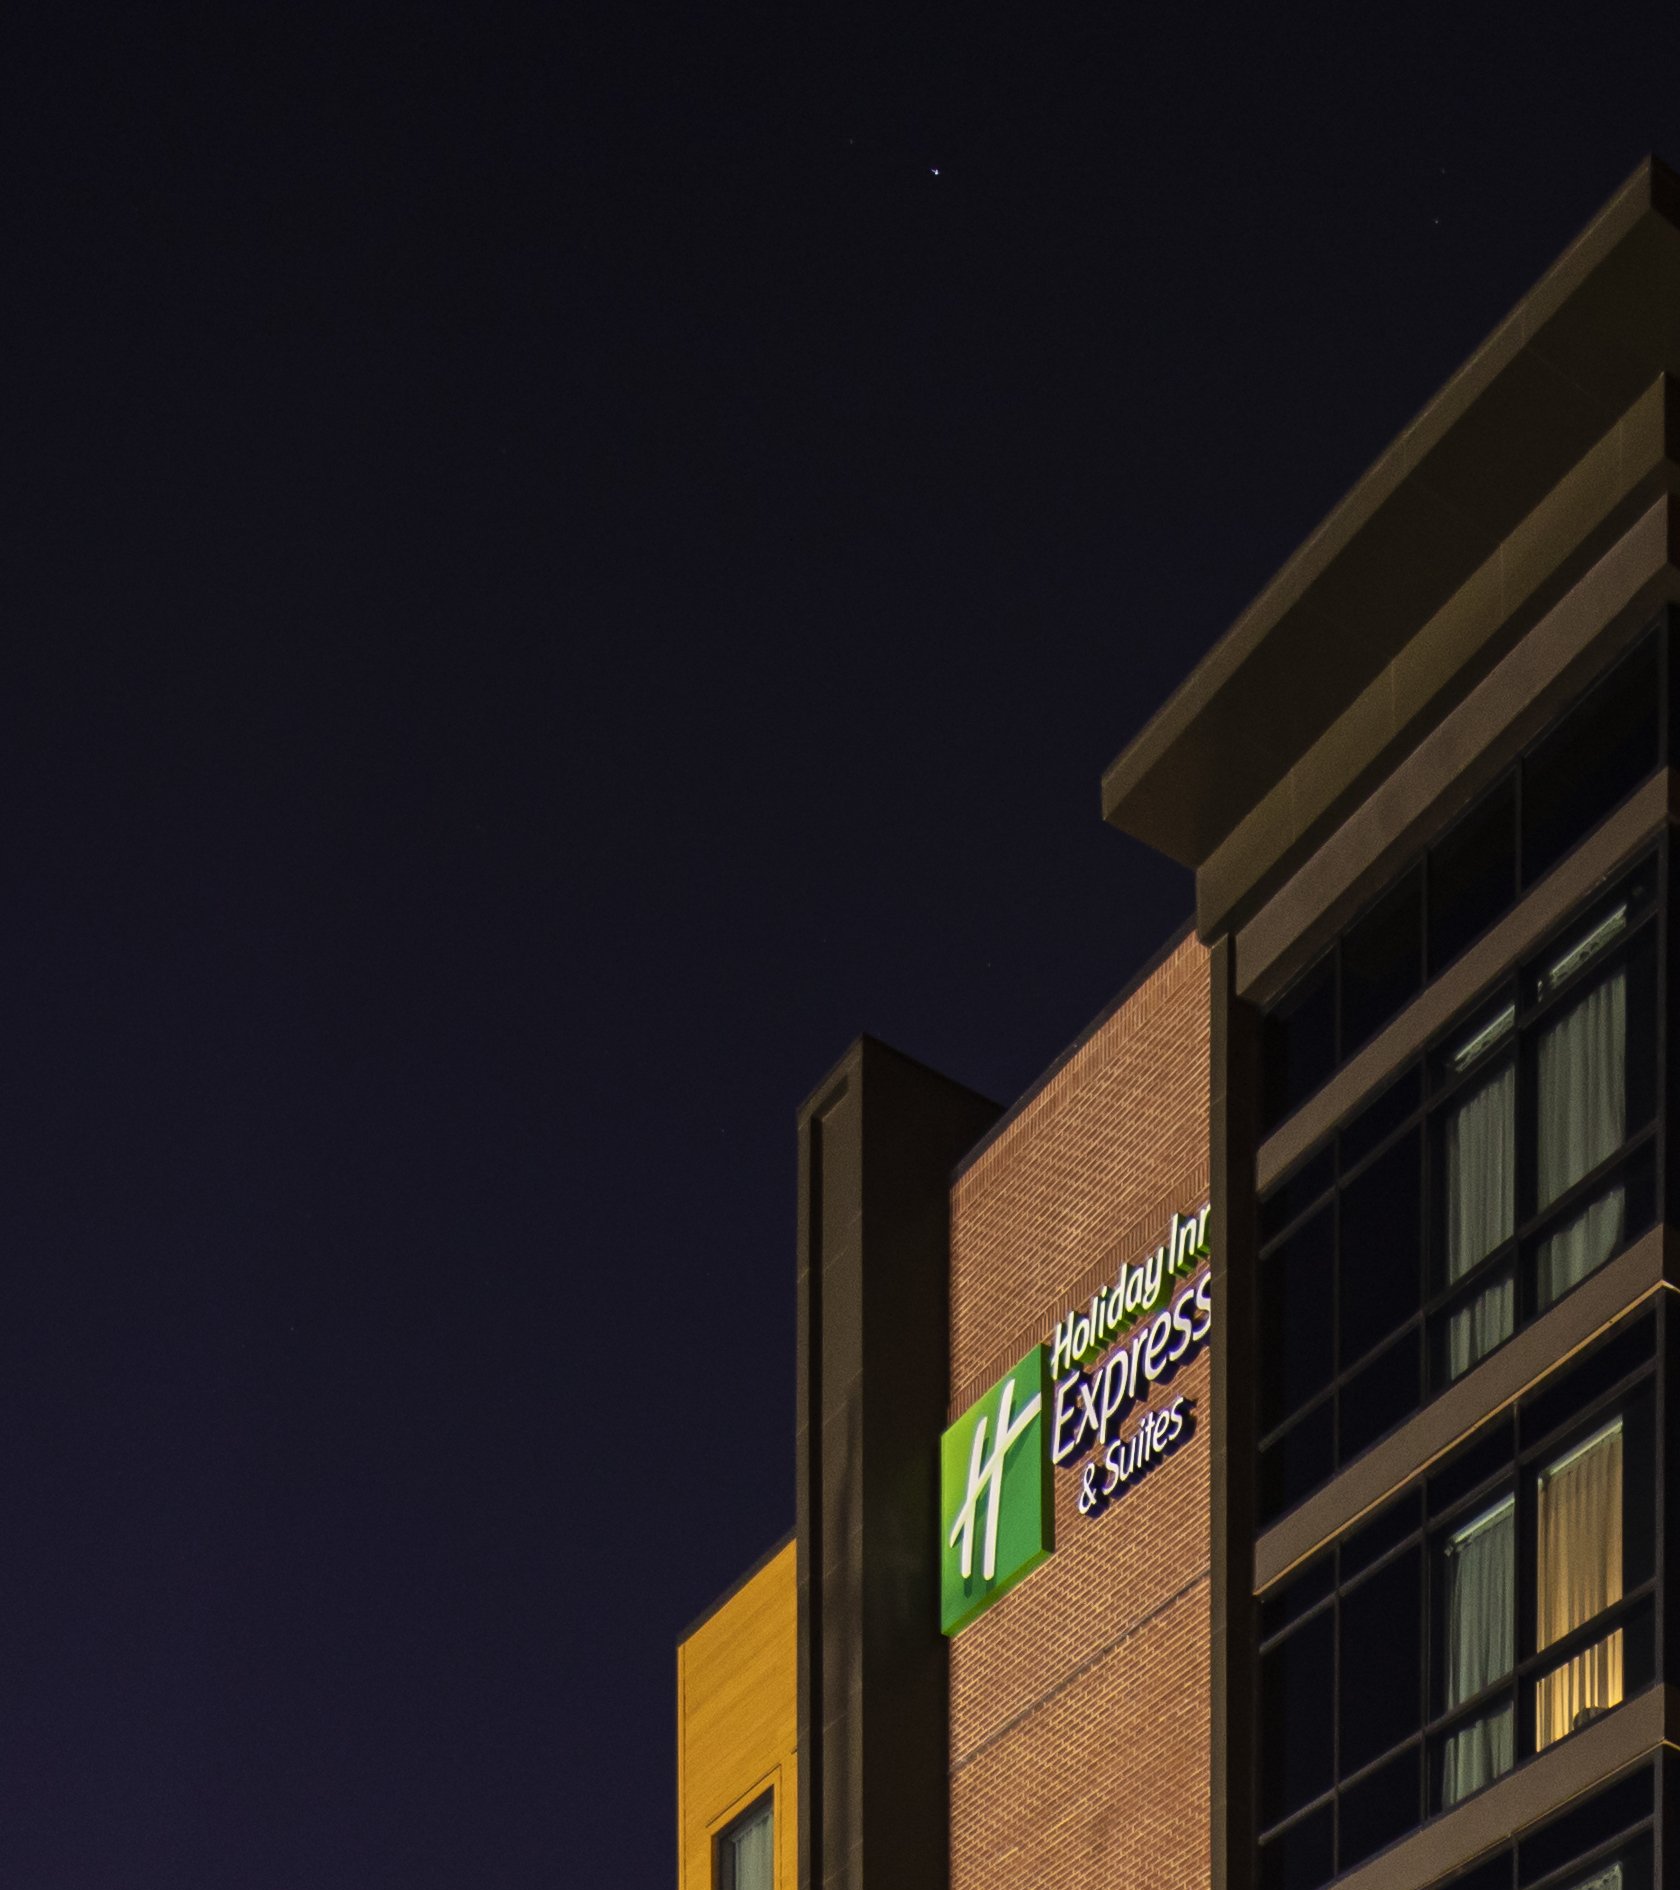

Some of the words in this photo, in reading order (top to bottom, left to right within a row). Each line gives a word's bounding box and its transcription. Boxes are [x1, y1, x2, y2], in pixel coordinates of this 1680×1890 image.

[1051, 1247, 1164, 1380] Holiday
[1052, 1271, 1211, 1465] Express
[1079, 1462, 1096, 1514] &
[1102, 1396, 1184, 1496] Suites
